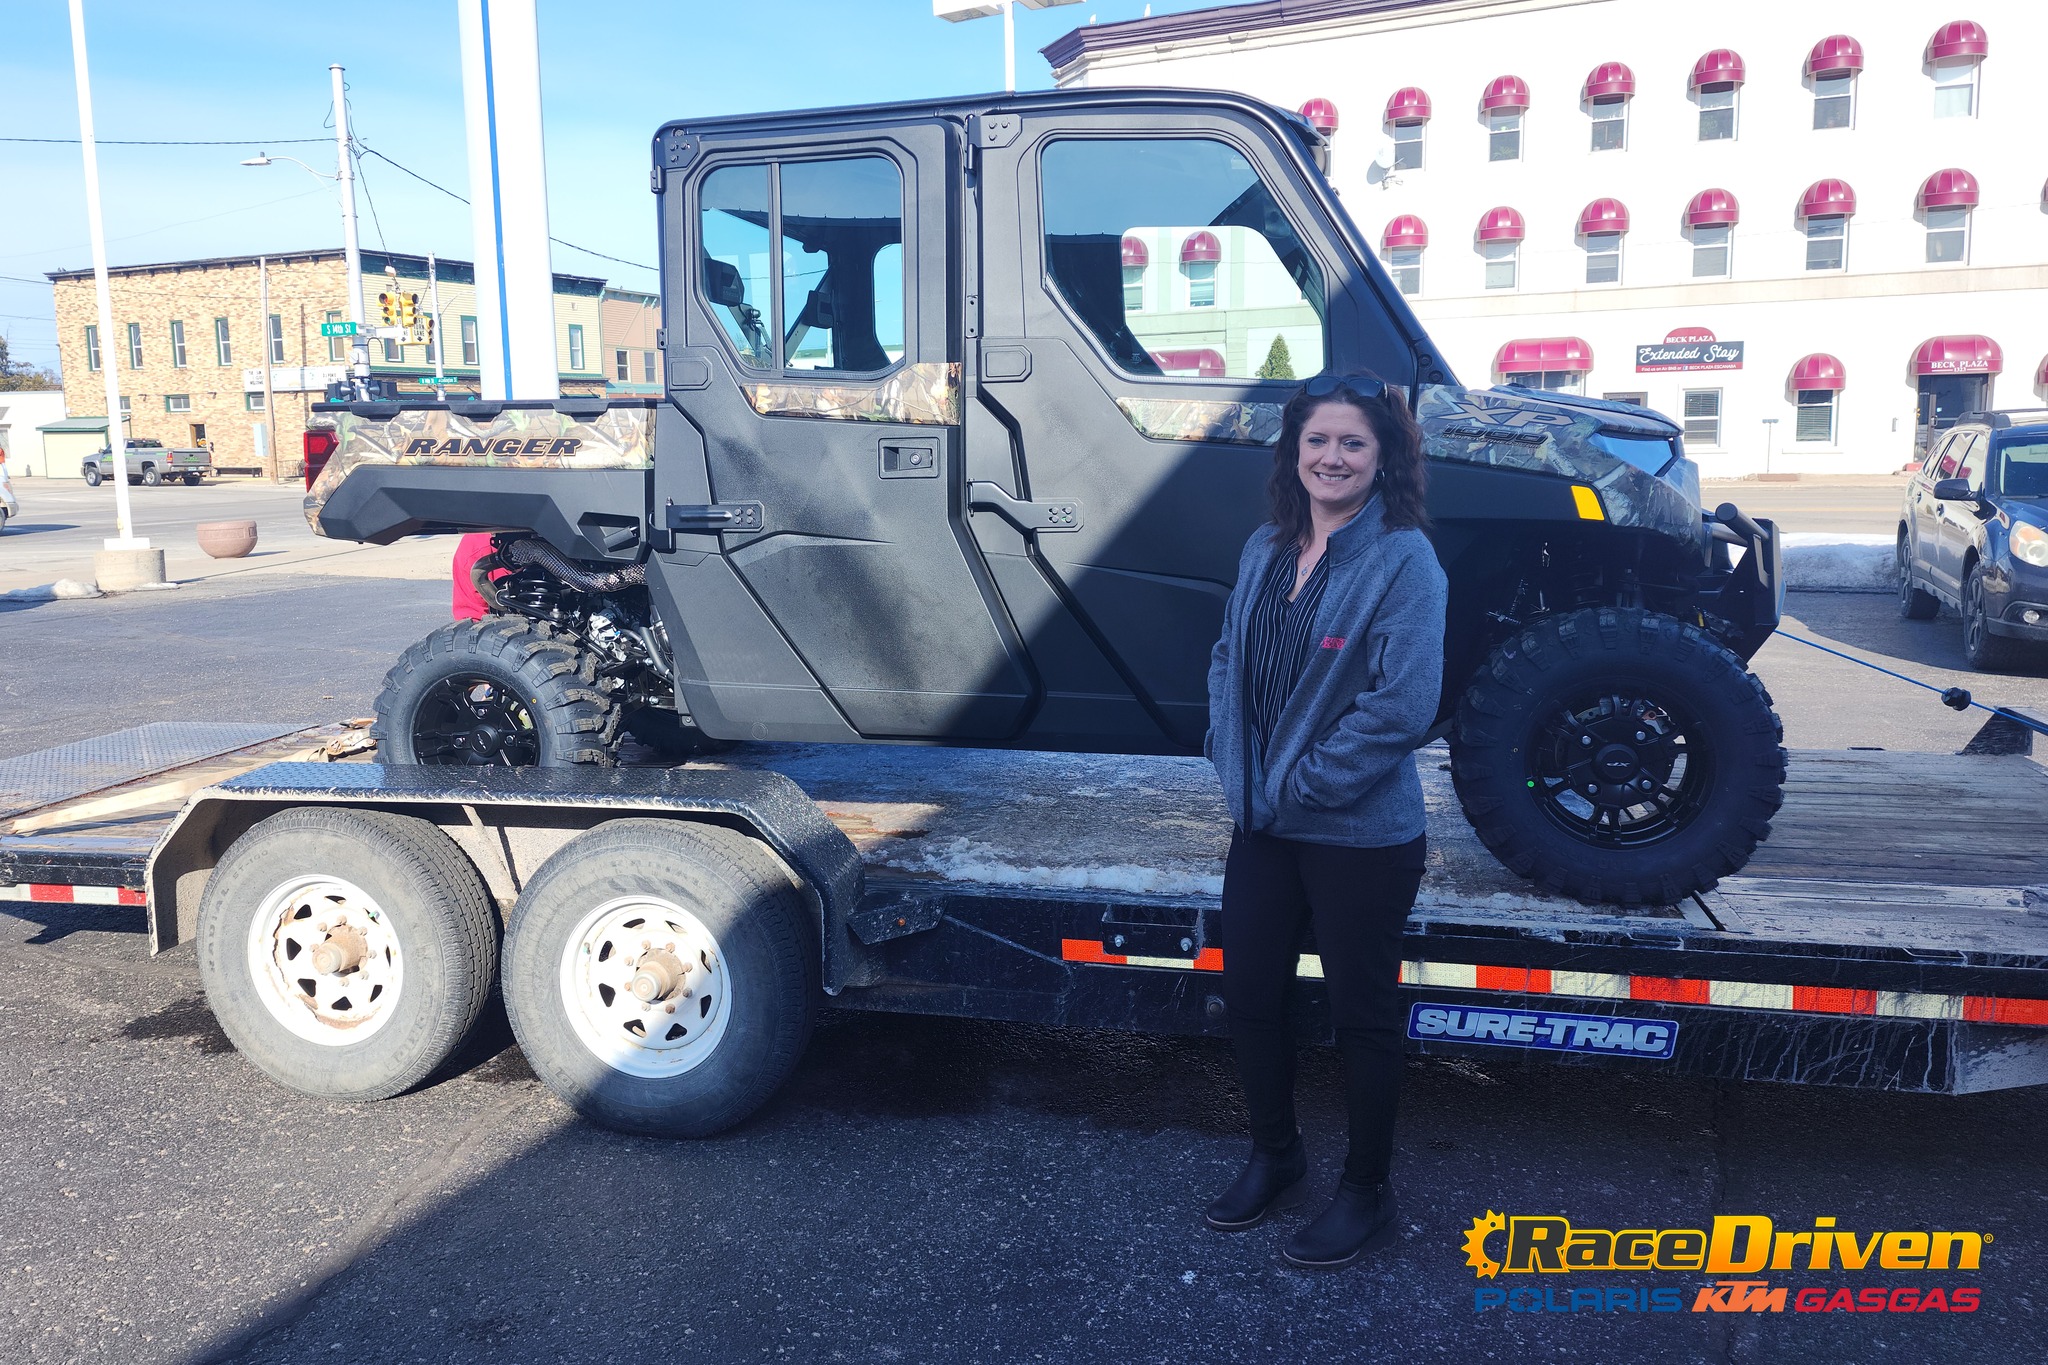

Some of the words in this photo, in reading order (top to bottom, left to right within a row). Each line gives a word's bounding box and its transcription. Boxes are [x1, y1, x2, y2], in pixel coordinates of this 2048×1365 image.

[332, 324, 344, 334] 14th
[1640, 347, 1700, 363] Extended
[1703, 345, 1739, 362] Stay
[1931, 361, 1955, 369] BECK
[1960, 360, 1988, 368] PLAZA
[1430, 401, 1576, 428] XP
[1441, 424, 1549, 445] 1000
[404, 438, 583, 456] RANGER
[1415, 1008, 1669, 1053] SURE-TRAC
